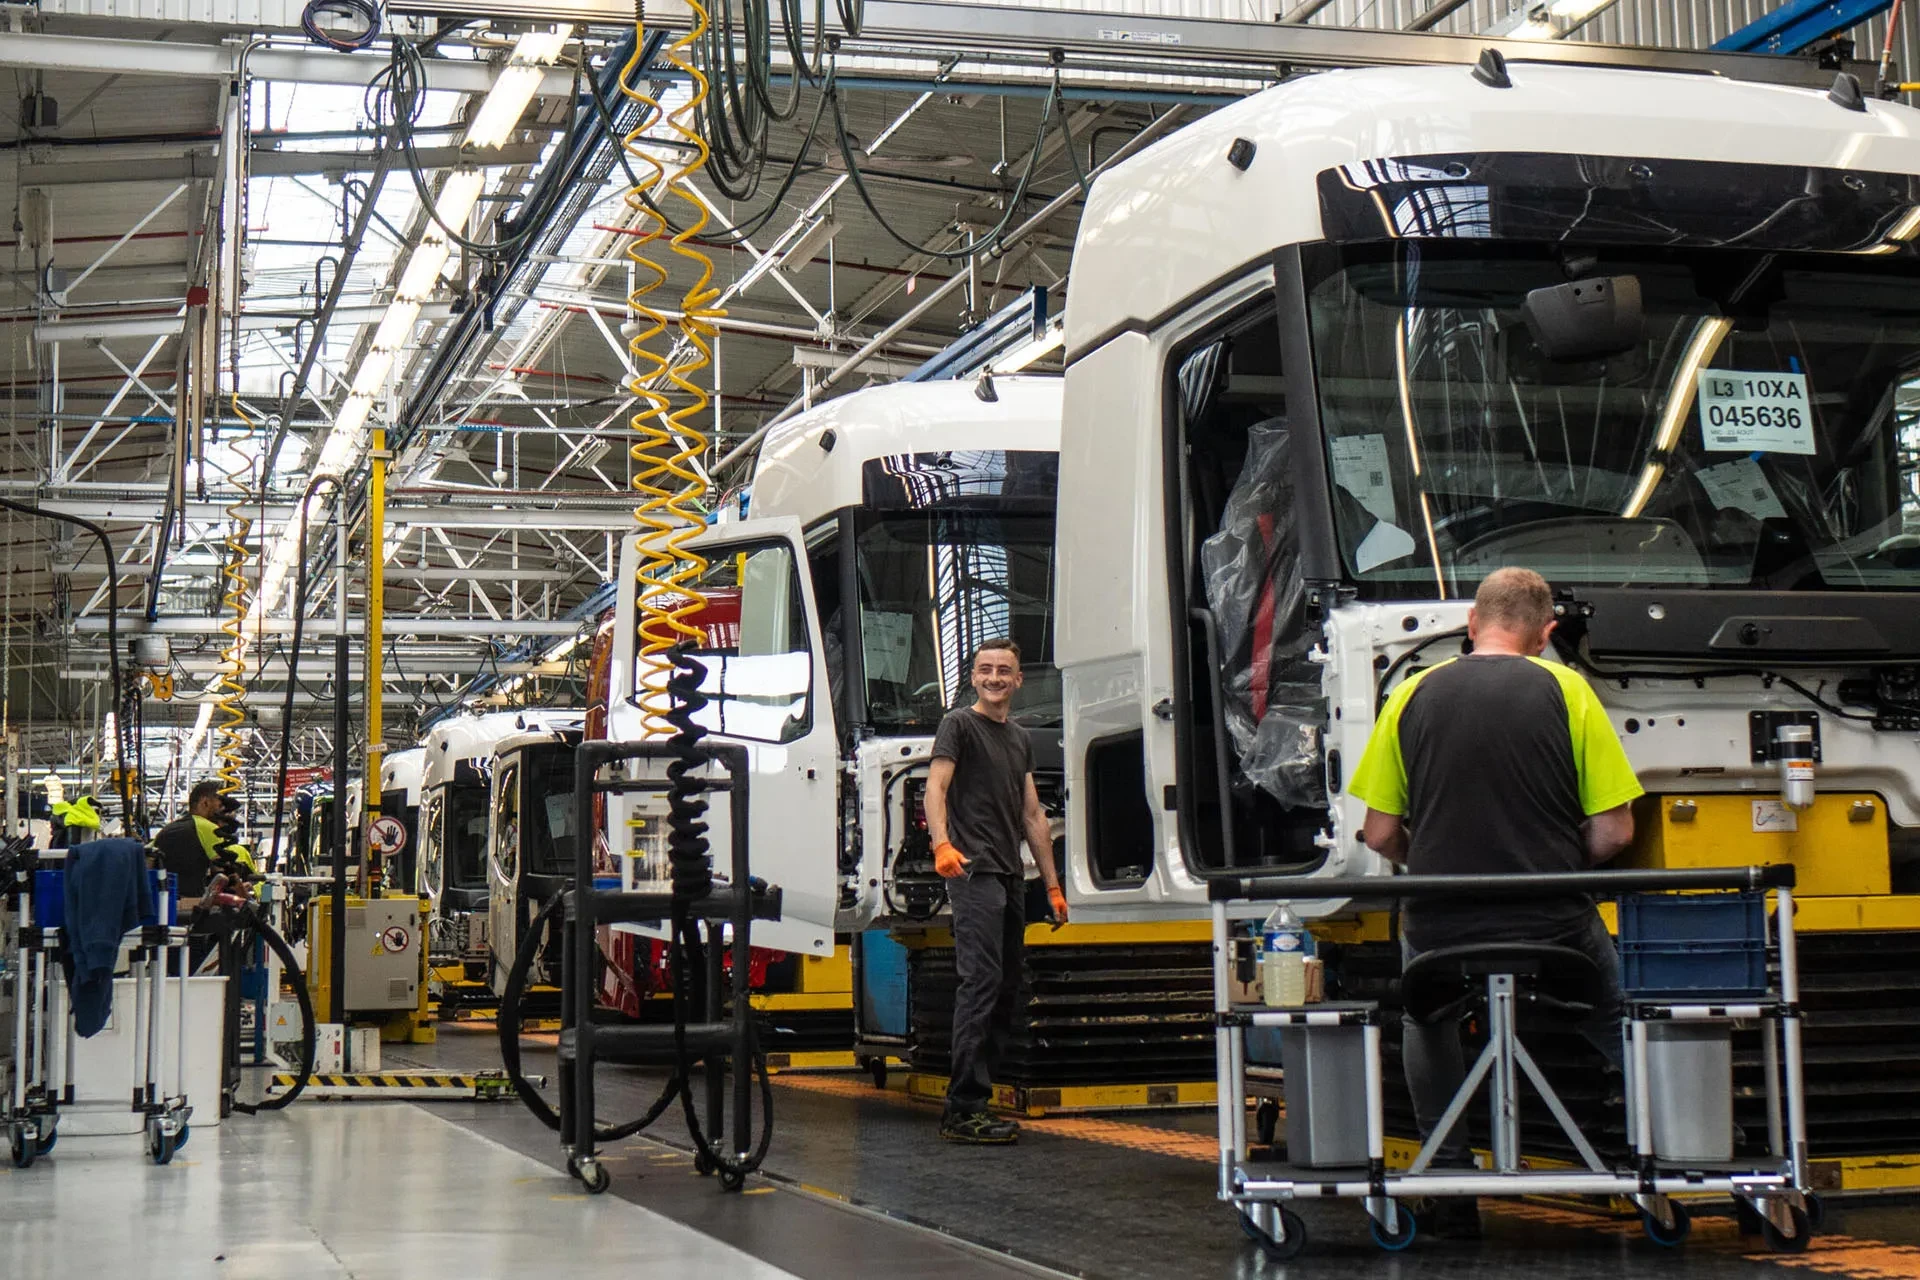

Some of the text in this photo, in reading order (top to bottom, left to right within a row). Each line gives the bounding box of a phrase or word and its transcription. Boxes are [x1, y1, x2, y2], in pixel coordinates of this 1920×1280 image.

[1713, 380, 1802, 399] L3 10XA
[1708, 405, 1802, 429] 045636
